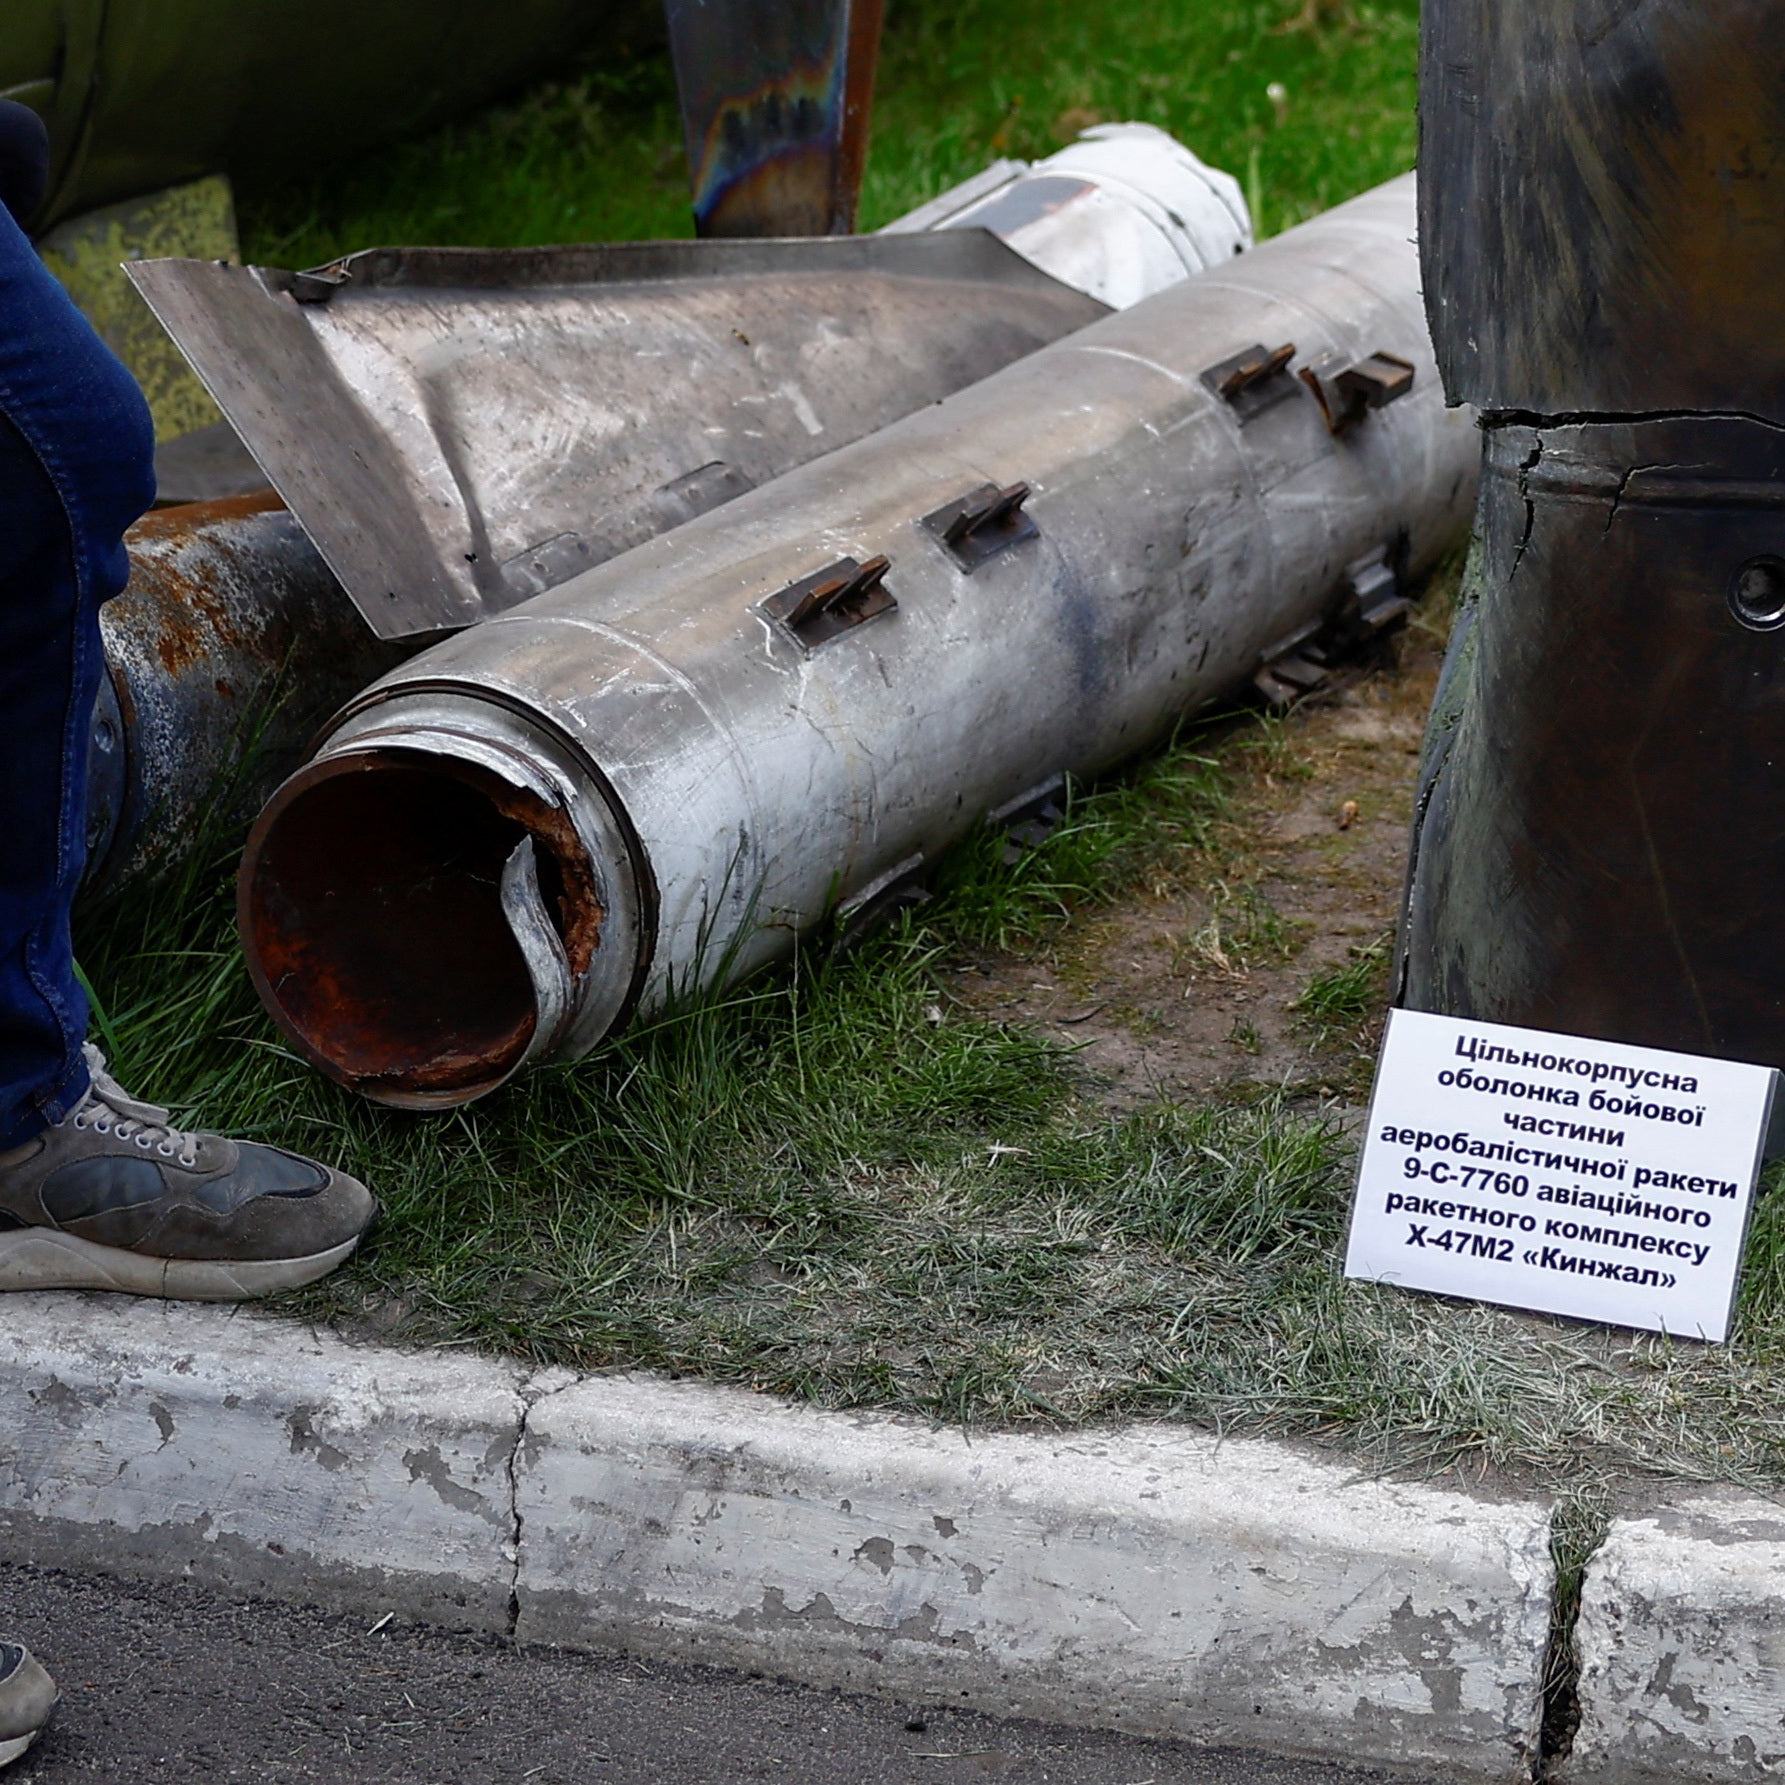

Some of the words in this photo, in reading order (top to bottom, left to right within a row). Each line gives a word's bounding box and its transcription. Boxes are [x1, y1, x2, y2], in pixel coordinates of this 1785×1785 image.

[1437, 1068, 1580, 1107] оболонка
[1588, 1089, 1707, 1127] бойової
[1455, 1035, 1698, 1094] Цільнокорпусна
[1380, 1125, 1629, 1181] аеробалістичної
[1632, 1167, 1738, 1200] ракети
[1503, 1112, 1625, 1148] частини
[1403, 1156, 1530, 1198] 9-С-7760
[1536, 1184, 1712, 1228] авіаційного
[1384, 1192, 1537, 1232] ракетного
[1544, 1219, 1711, 1267] комплексу
[1405, 1223, 1515, 1263] Х-47М2
[1522, 1245, 1677, 1289] «Кинжал»
